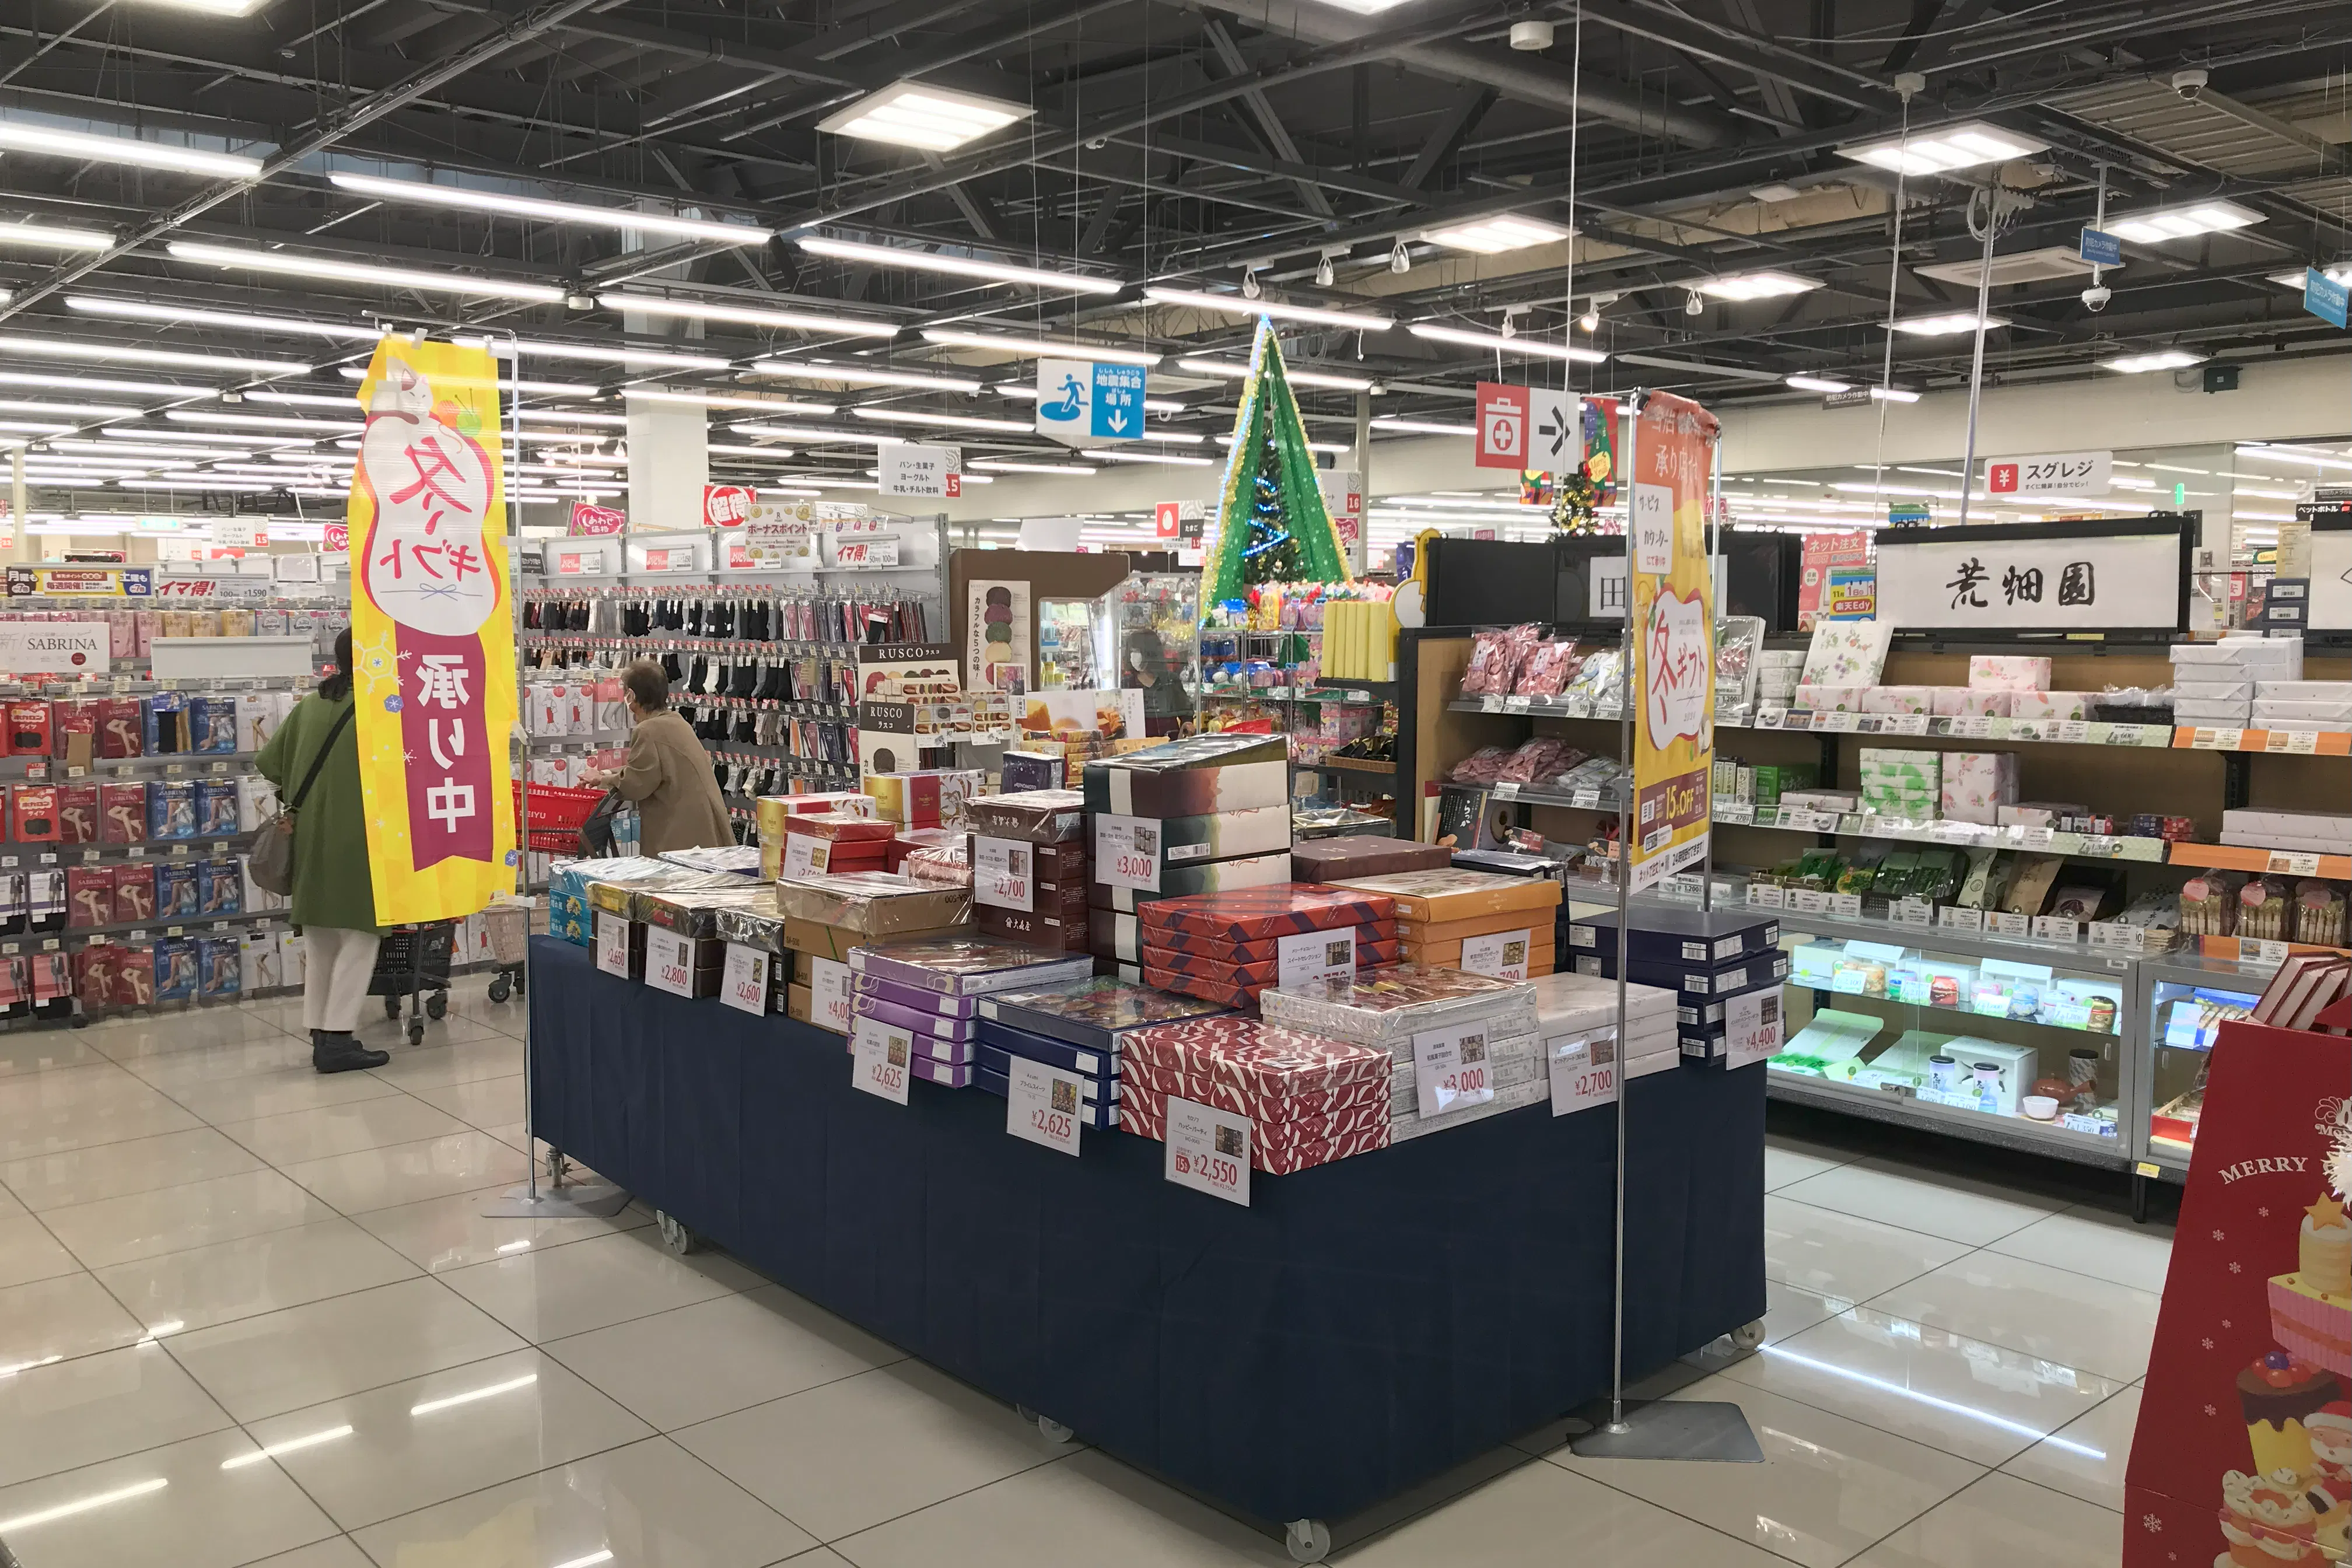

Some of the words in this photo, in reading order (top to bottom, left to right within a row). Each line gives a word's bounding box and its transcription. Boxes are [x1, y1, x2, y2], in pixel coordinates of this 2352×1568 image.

[1096, 373, 1142, 388] 地震集合
[1105, 393, 1132, 407] 場所
[900, 461, 935, 470] パン・生菓子
[2027, 460, 2094, 480] スグレジ
[901, 473, 930, 481] ヨーグルト
[582, 514, 614, 525] しあわせ
[747, 523, 807, 534] ボーナスポイント
[256, 535, 268, 544] 15
[1809, 537, 1860, 552] ネット注文
[838, 544, 867, 562] イマ得!
[159, 580, 216, 596] イマ得!
[1946, 557, 2095, 611] 荒畑園
[1836, 600, 1871, 611] 楽天Edy
[27, 638, 98, 650] SABRINA
[972, 597, 981, 680] カラフルな5つの味!
[878, 648, 923, 659] RUSCO
[1677, 642, 1705, 691] ギフト
[870, 706, 902, 719] RUSCO
[1117, 856, 1152, 877] ¥3,000
[994, 877, 1025, 898] ¥2,700
[944, 893, 969, 903] SA-500
[608, 948, 625, 967] ¥2,650
[1292, 945, 1317, 954] メリーチョコレート
[1287, 953, 1322, 963] スイートセレクション
[662, 964, 688, 985] ¥2,800
[737, 982, 761, 1003] ¥2,600
[828, 1000, 850, 1020] ¥4,00
[1746, 1026, 1776, 1051] ¥4,400
[872, 1063, 902, 1089] ¥2,625
[1444, 1068, 1484, 1097] ¥3,000
[1575, 1069, 1612, 1097] ¥2,700
[1020, 1080, 1045, 1091] プライムスイーツ
[1032, 1109, 1072, 1138] ¥2,625
[1187, 1115, 1199, 1123] モロゾフ
[1178, 1122, 1208, 1136] ハッピーパーティ
[1194, 1154, 1237, 1186] ¥2,550
[2218, 1156, 2308, 1185] MERRY
